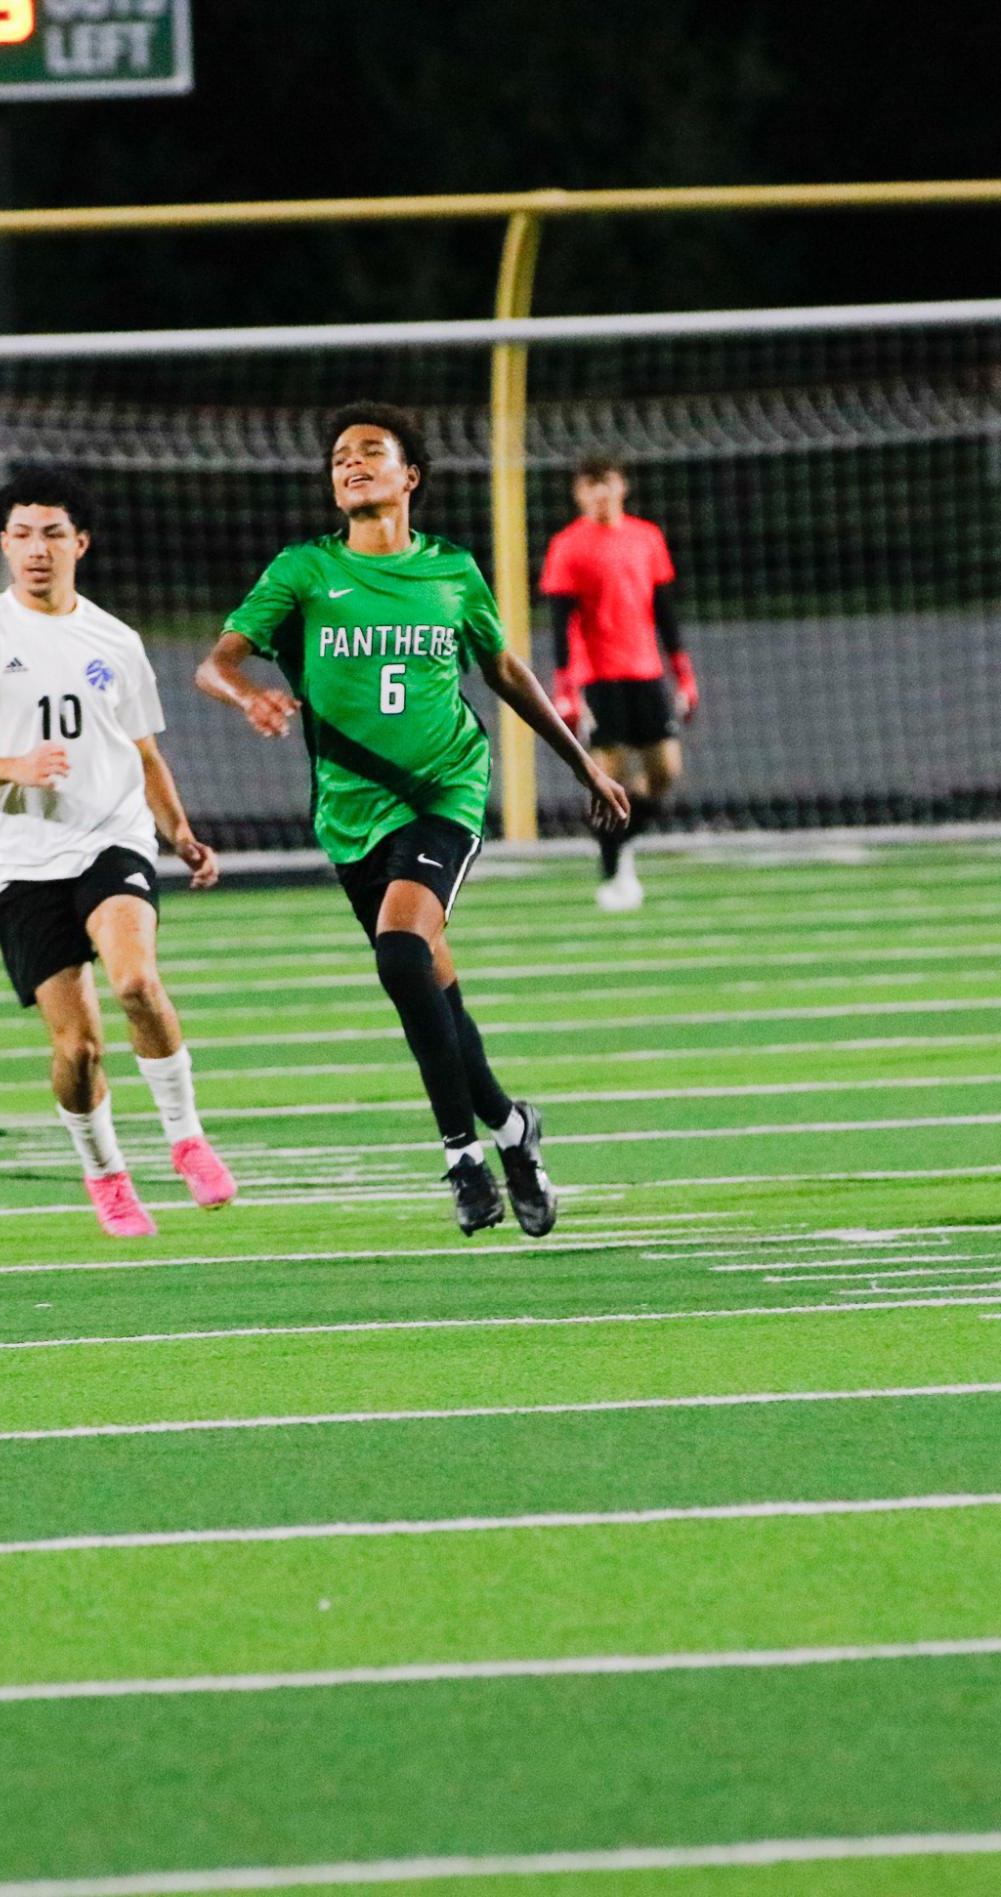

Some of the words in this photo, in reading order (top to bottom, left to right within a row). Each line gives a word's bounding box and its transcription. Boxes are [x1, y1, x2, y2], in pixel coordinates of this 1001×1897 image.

[46, 23, 153, 73] LEFT
[319, 625, 457, 657] PANTHERS
[379, 664, 406, 715] 6
[37, 694, 82, 740] 10
